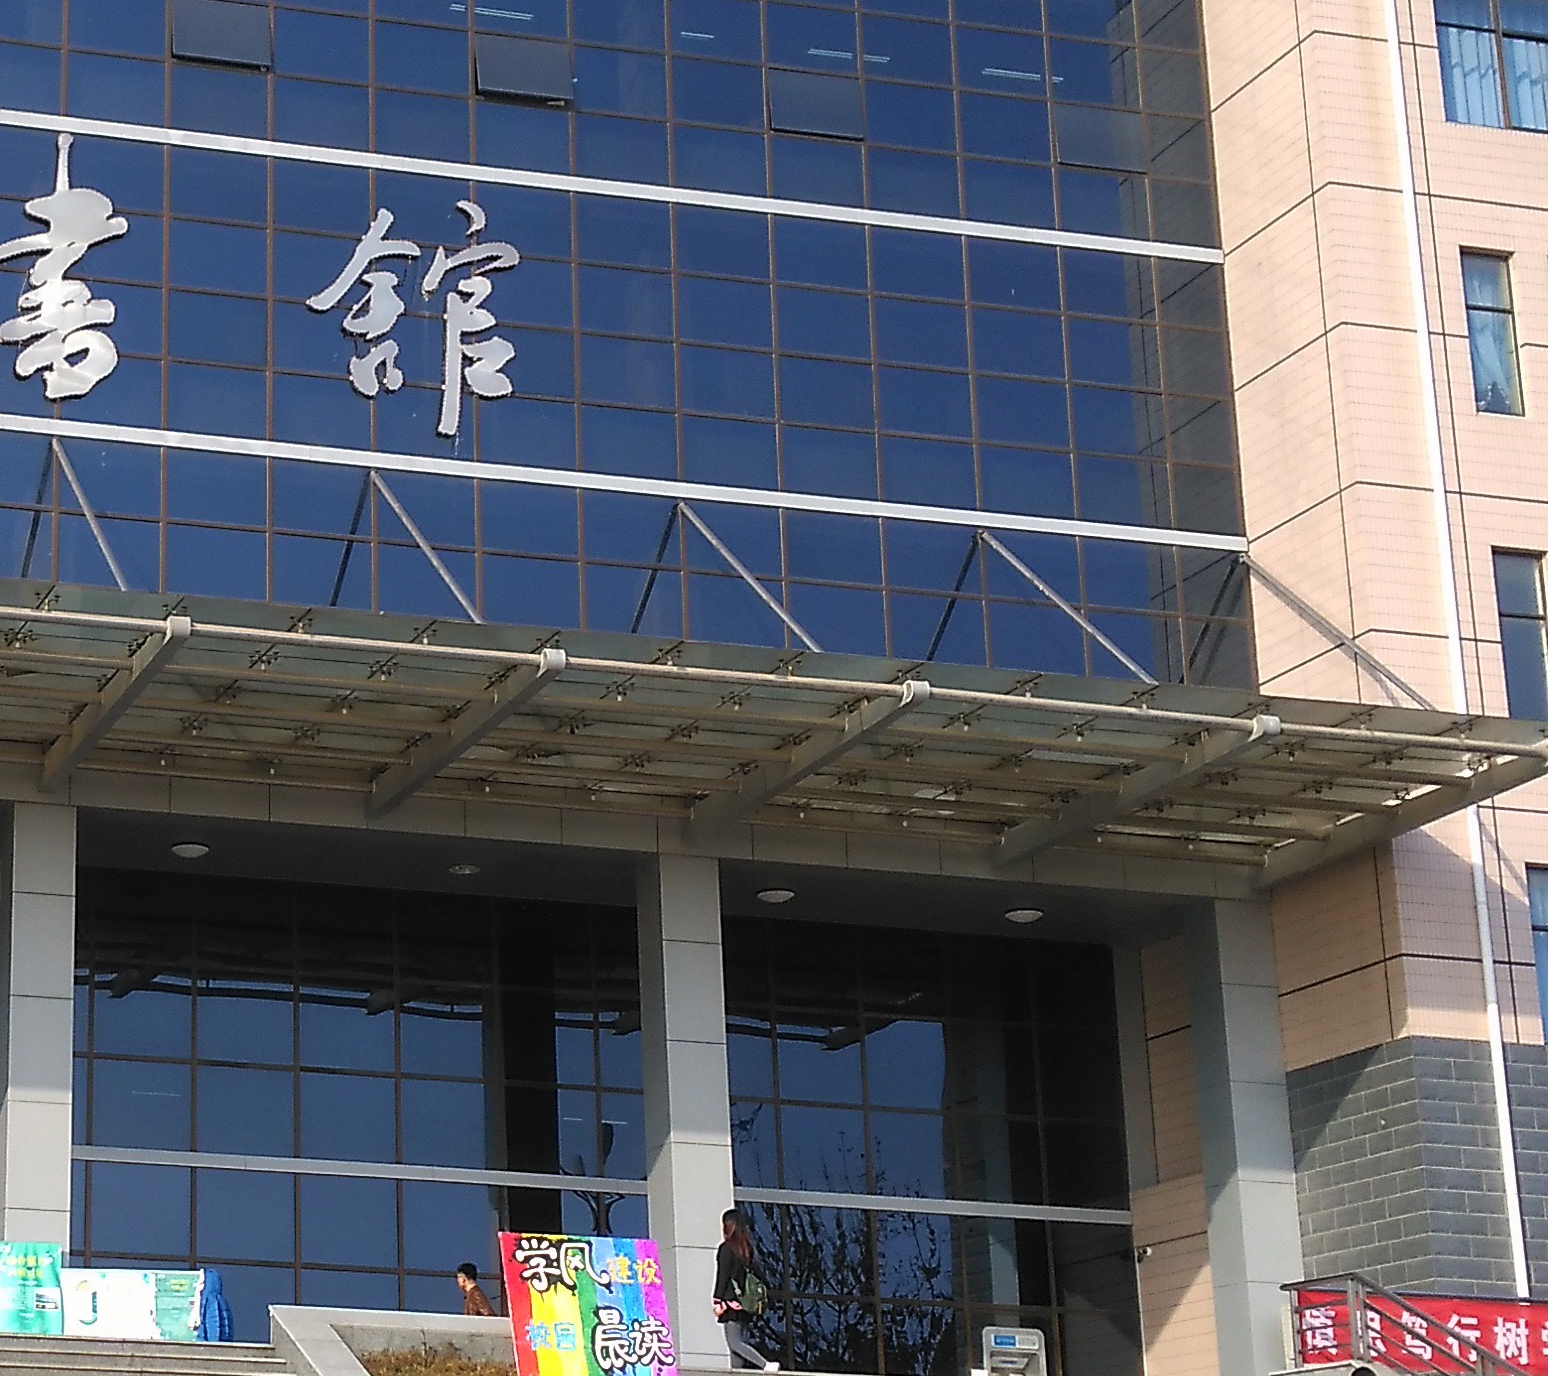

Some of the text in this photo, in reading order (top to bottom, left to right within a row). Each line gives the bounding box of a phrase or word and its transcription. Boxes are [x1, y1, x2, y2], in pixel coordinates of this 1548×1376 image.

[1301, 1306, 1548, 1365] 慎思笃行树
